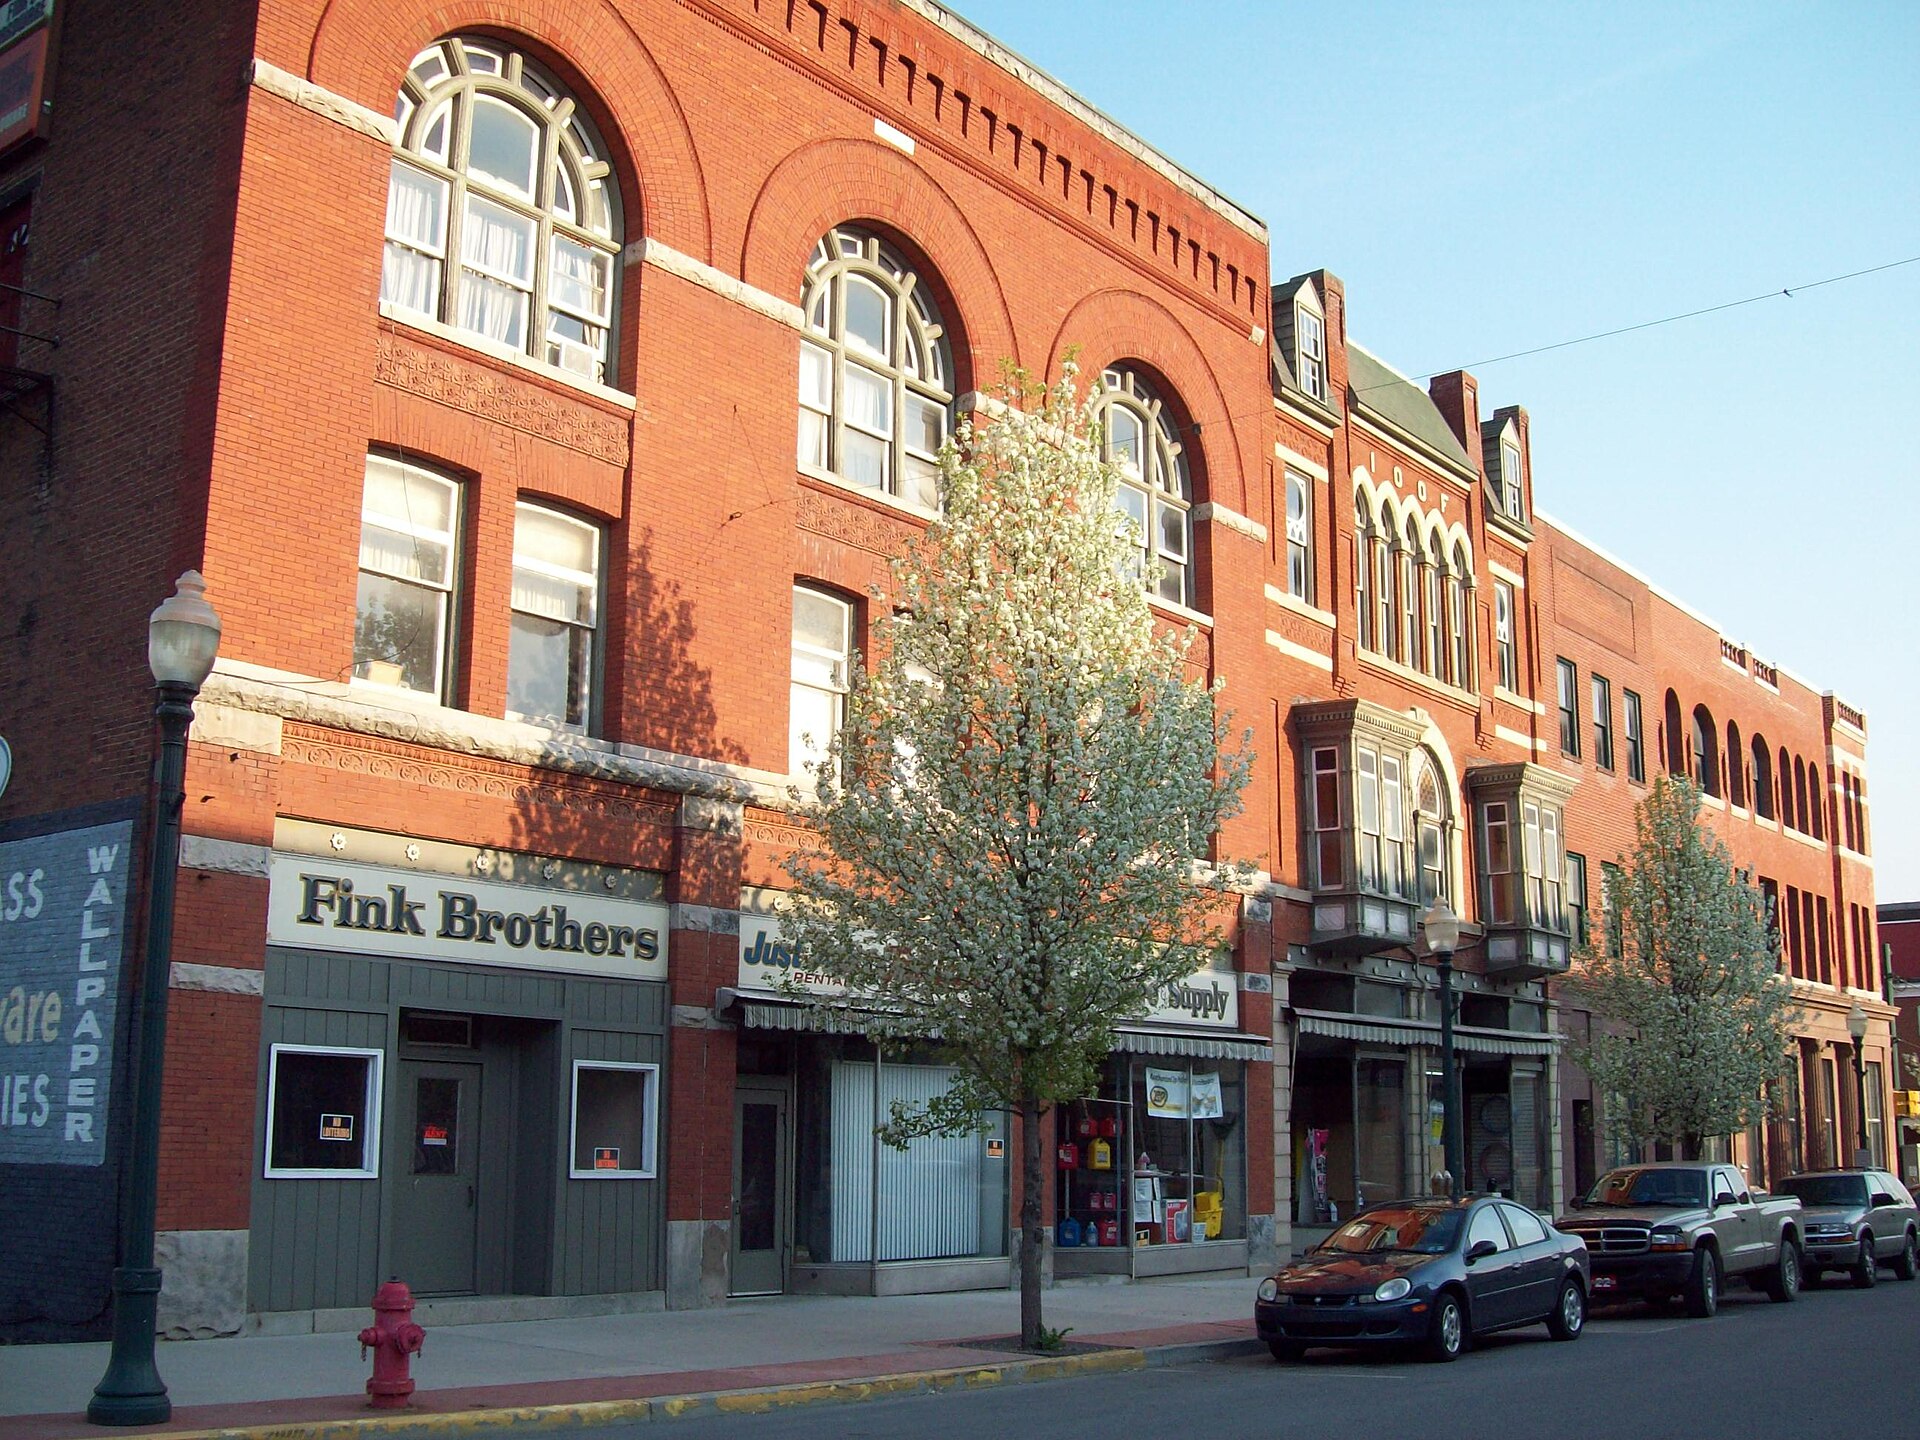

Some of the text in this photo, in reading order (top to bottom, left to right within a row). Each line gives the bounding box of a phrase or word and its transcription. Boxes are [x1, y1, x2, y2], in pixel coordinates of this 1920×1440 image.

[0, 868, 44, 922] SS
[297, 872, 659, 962] Fink Brothers
[0, 985, 62, 1045] are
[65, 844, 119, 1143] WALLPAPER
[1168, 979, 1230, 1021] Supply
